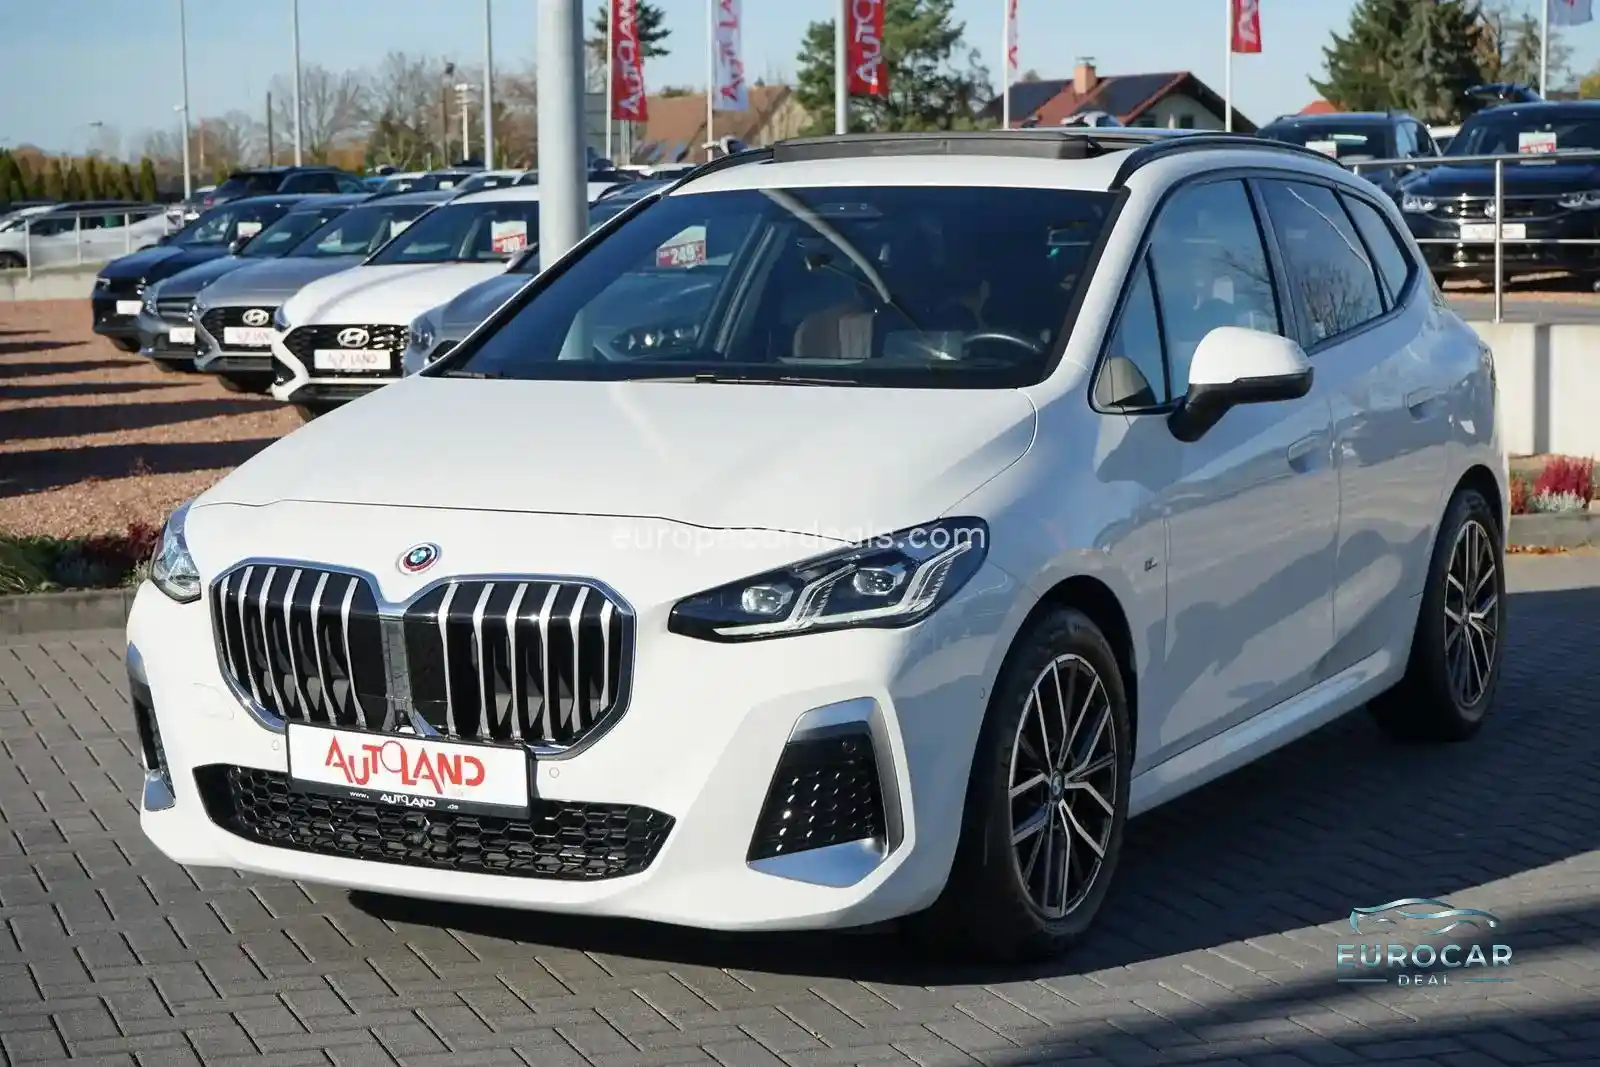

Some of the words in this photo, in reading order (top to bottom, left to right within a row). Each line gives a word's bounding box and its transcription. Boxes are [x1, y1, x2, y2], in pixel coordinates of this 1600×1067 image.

[617, 0, 643, 114] AUTOLAN
[325, 735, 485, 794] AUTOLAND
[380, 793, 436, 808] AUTOLAND
